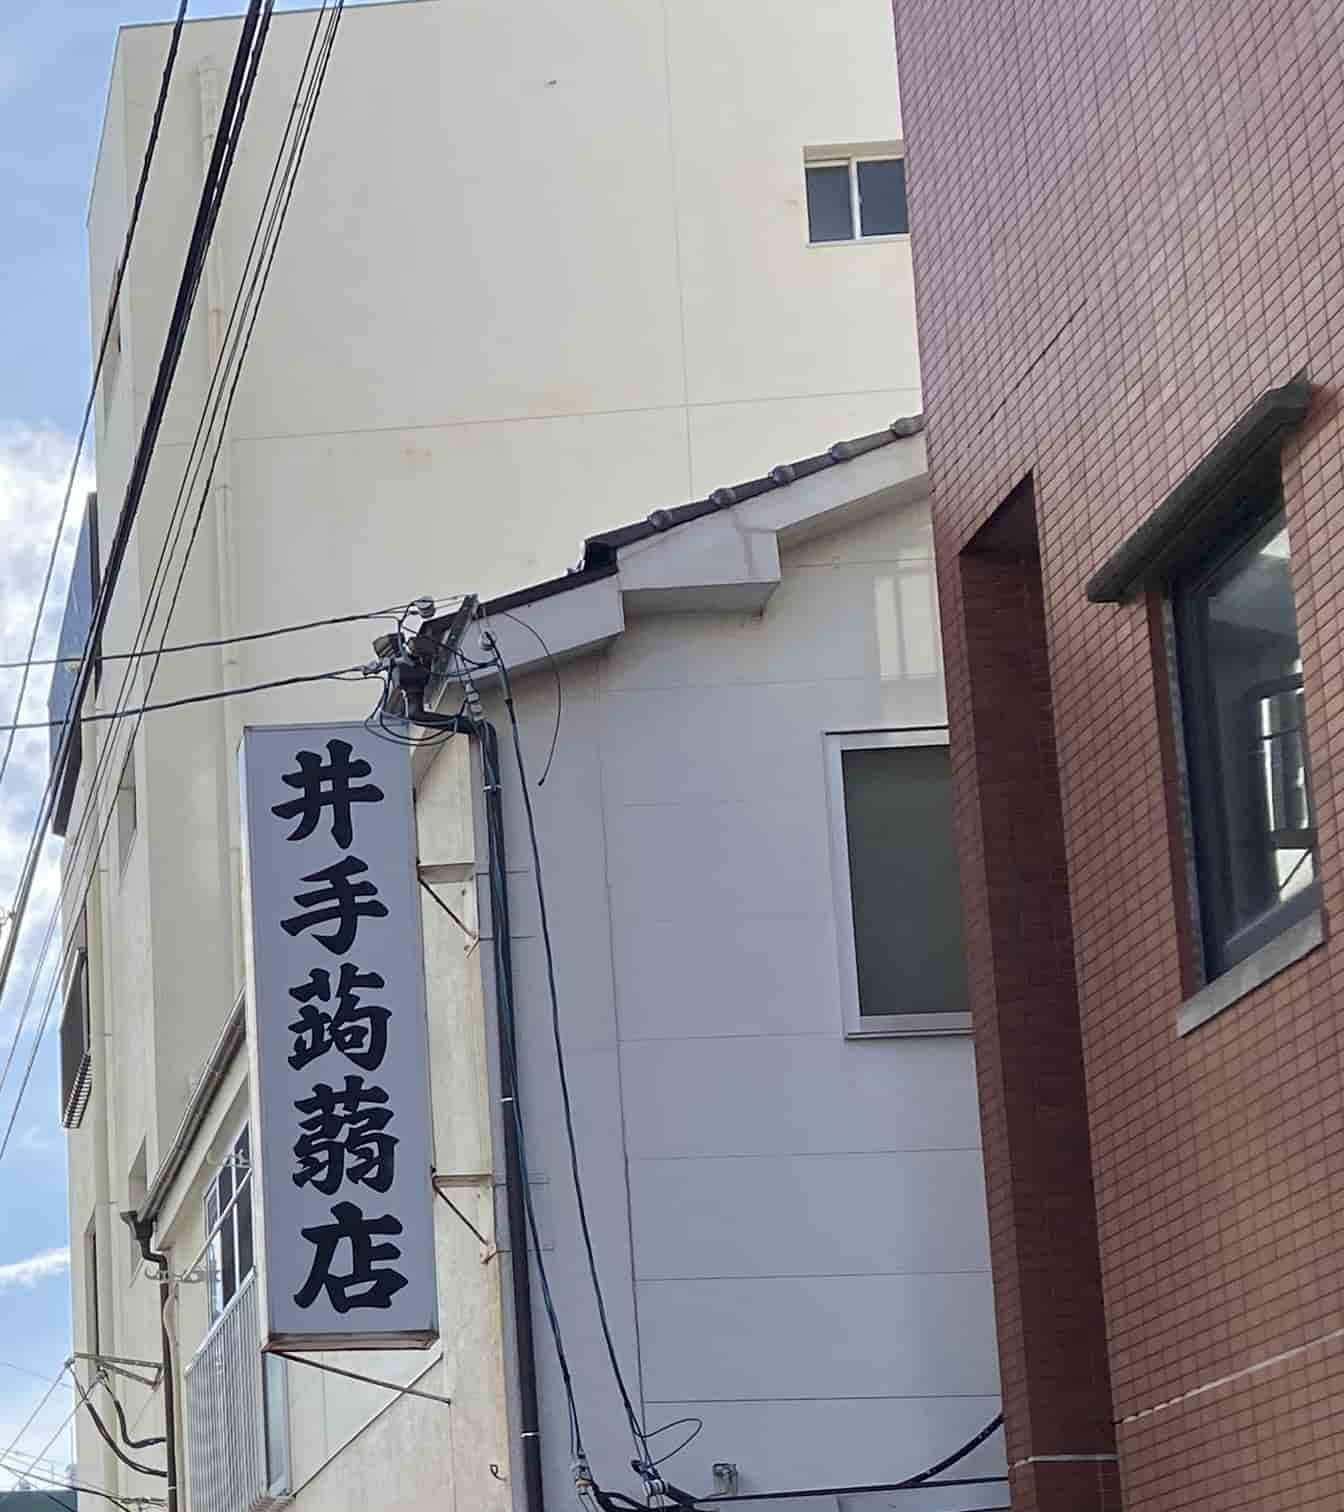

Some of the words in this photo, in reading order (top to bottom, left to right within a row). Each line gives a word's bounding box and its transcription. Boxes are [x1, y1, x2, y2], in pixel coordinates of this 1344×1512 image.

[271, 738, 409, 1313] 井手蒟蒻店
